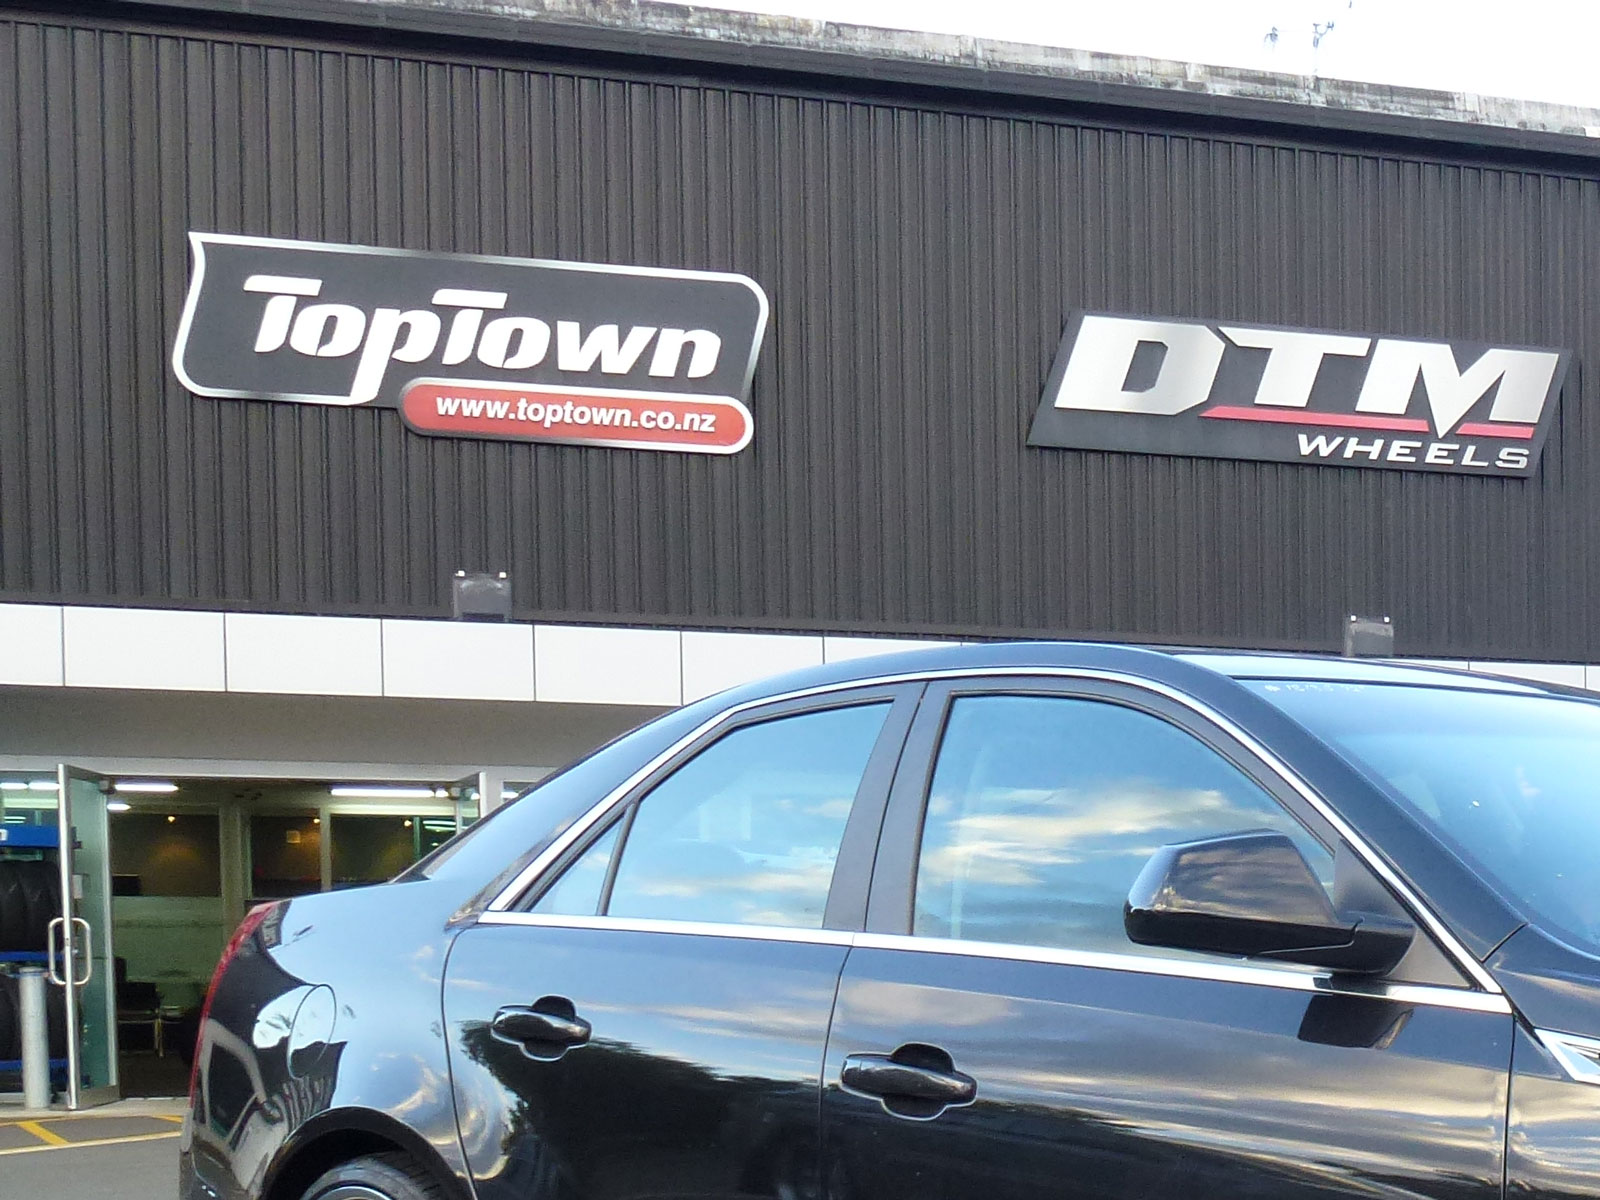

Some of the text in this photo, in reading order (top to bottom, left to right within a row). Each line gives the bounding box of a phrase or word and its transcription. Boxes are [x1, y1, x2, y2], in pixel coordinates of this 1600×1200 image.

[243, 274, 722, 405] TopTown
[1054, 315, 1560, 438] DTM
[436, 394, 716, 433] www.toptown.co.nz
[1298, 433, 1531, 469] WHEELS
